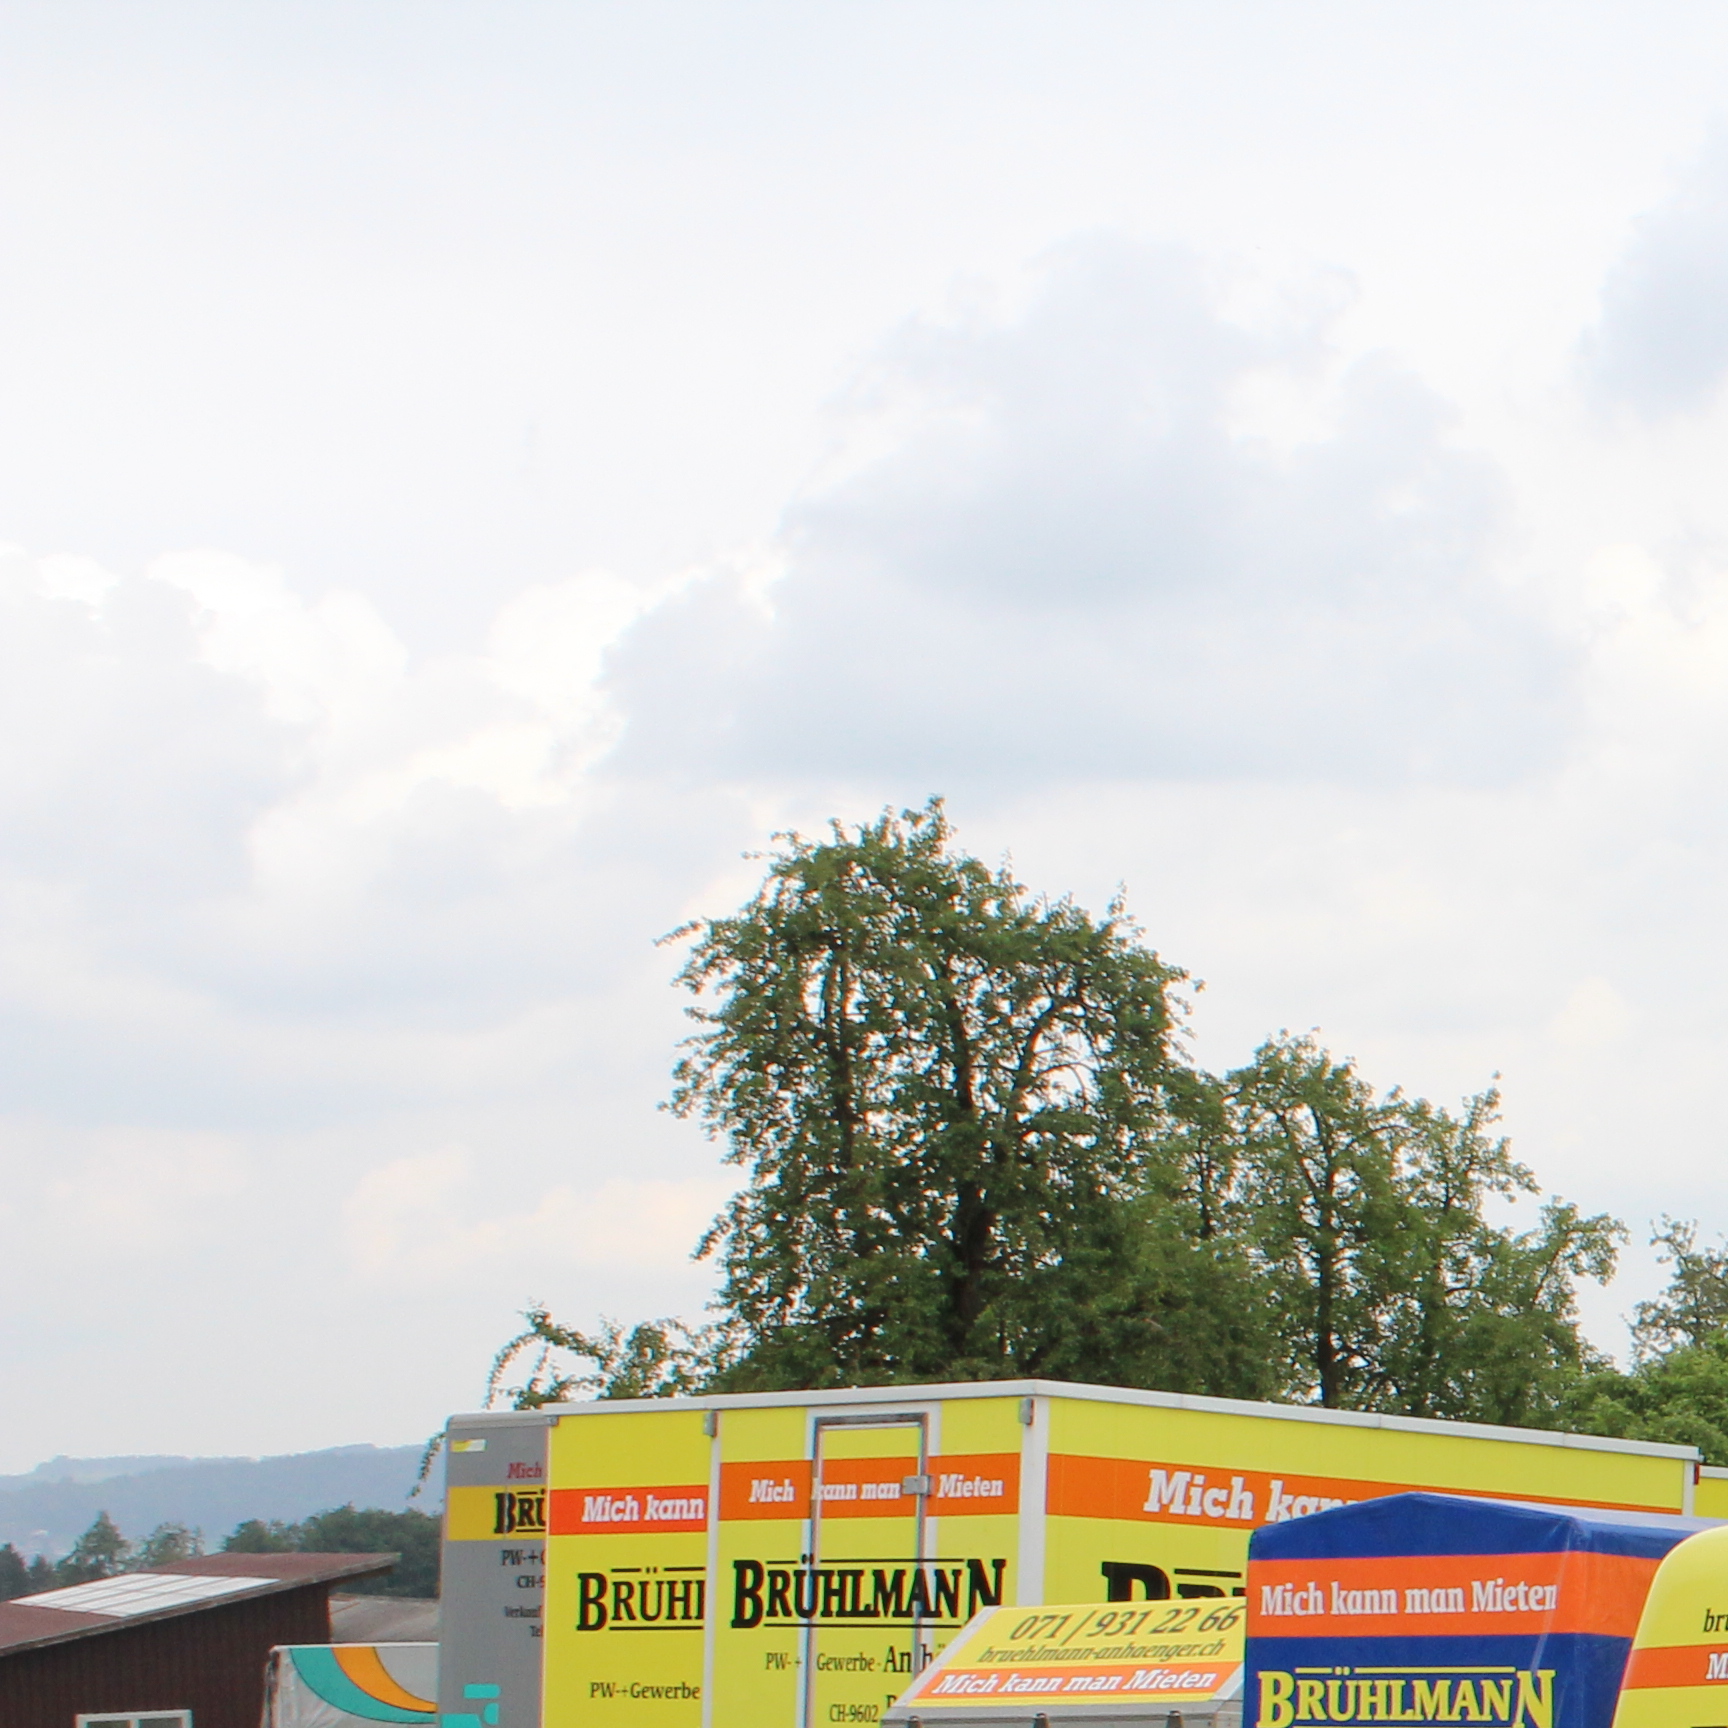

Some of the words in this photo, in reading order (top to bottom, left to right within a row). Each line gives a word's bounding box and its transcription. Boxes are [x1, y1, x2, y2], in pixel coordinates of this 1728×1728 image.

[749, 1479, 795, 1503] Mich
[860, 1482, 900, 1500] man
[937, 1473, 1004, 1498] Mieten
[1143, 1469, 1253, 1520] Mich
[581, 1496, 640, 1522] Mich
[644, 1495, 704, 1520] kann
[730, 1553, 1006, 1628] BRÜHLMANN
[1260, 1582, 1324, 1616] Mich
[1330, 1582, 1398, 1615] kann
[1404, 1587, 1465, 1614] man
[1471, 1578, 1557, 1612] Mieten
[1010, 1614, 1073, 1640] 071
[1086, 1610, 1153, 1637] 931
[1151, 1608, 1192, 1634] 22
[1197, 1605, 1246, 1632] 66
[931, 1674, 1000, 1694] Mich
[1001, 1673, 1062, 1692] kann
[1063, 1674, 1119, 1691] man
[1122, 1669, 1217, 1689] Mieten
